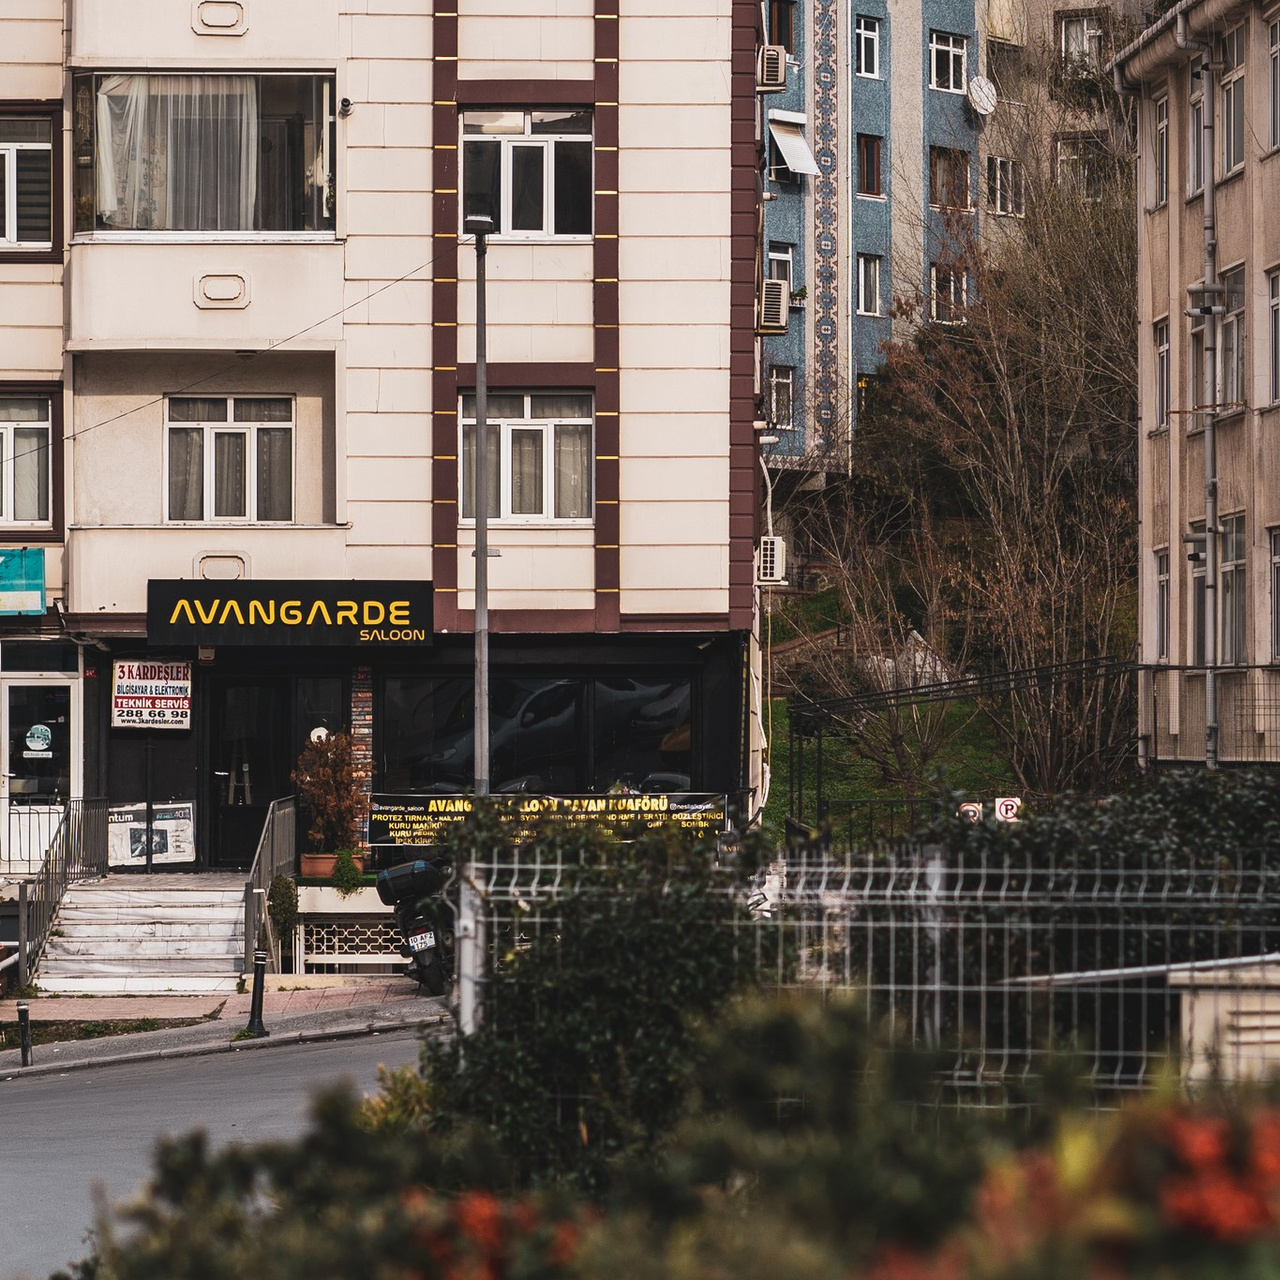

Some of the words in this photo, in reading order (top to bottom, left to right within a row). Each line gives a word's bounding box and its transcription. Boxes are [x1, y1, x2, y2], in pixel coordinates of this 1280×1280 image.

[169, 599, 411, 625] AVANGARDE
[359, 629, 425, 641] SALOON
[117, 664, 126, 680] 3
[127, 664, 190, 685] KARDEŞLER
[116, 683, 148, 695] BİLGİSAYAR
[154, 684, 189, 696] ELEKTRONİK
[116, 697, 153, 708] TEKNİK
[154, 697, 189, 708] SERVİS
[116, 709, 144, 718] 288
[148, 710, 166, 718] 66
[170, 711, 189, 719] 98
[404, 814, 433, 822] TIRNAK
[388, 822, 411, 830] KURU
[389, 830, 412, 838] KURU
